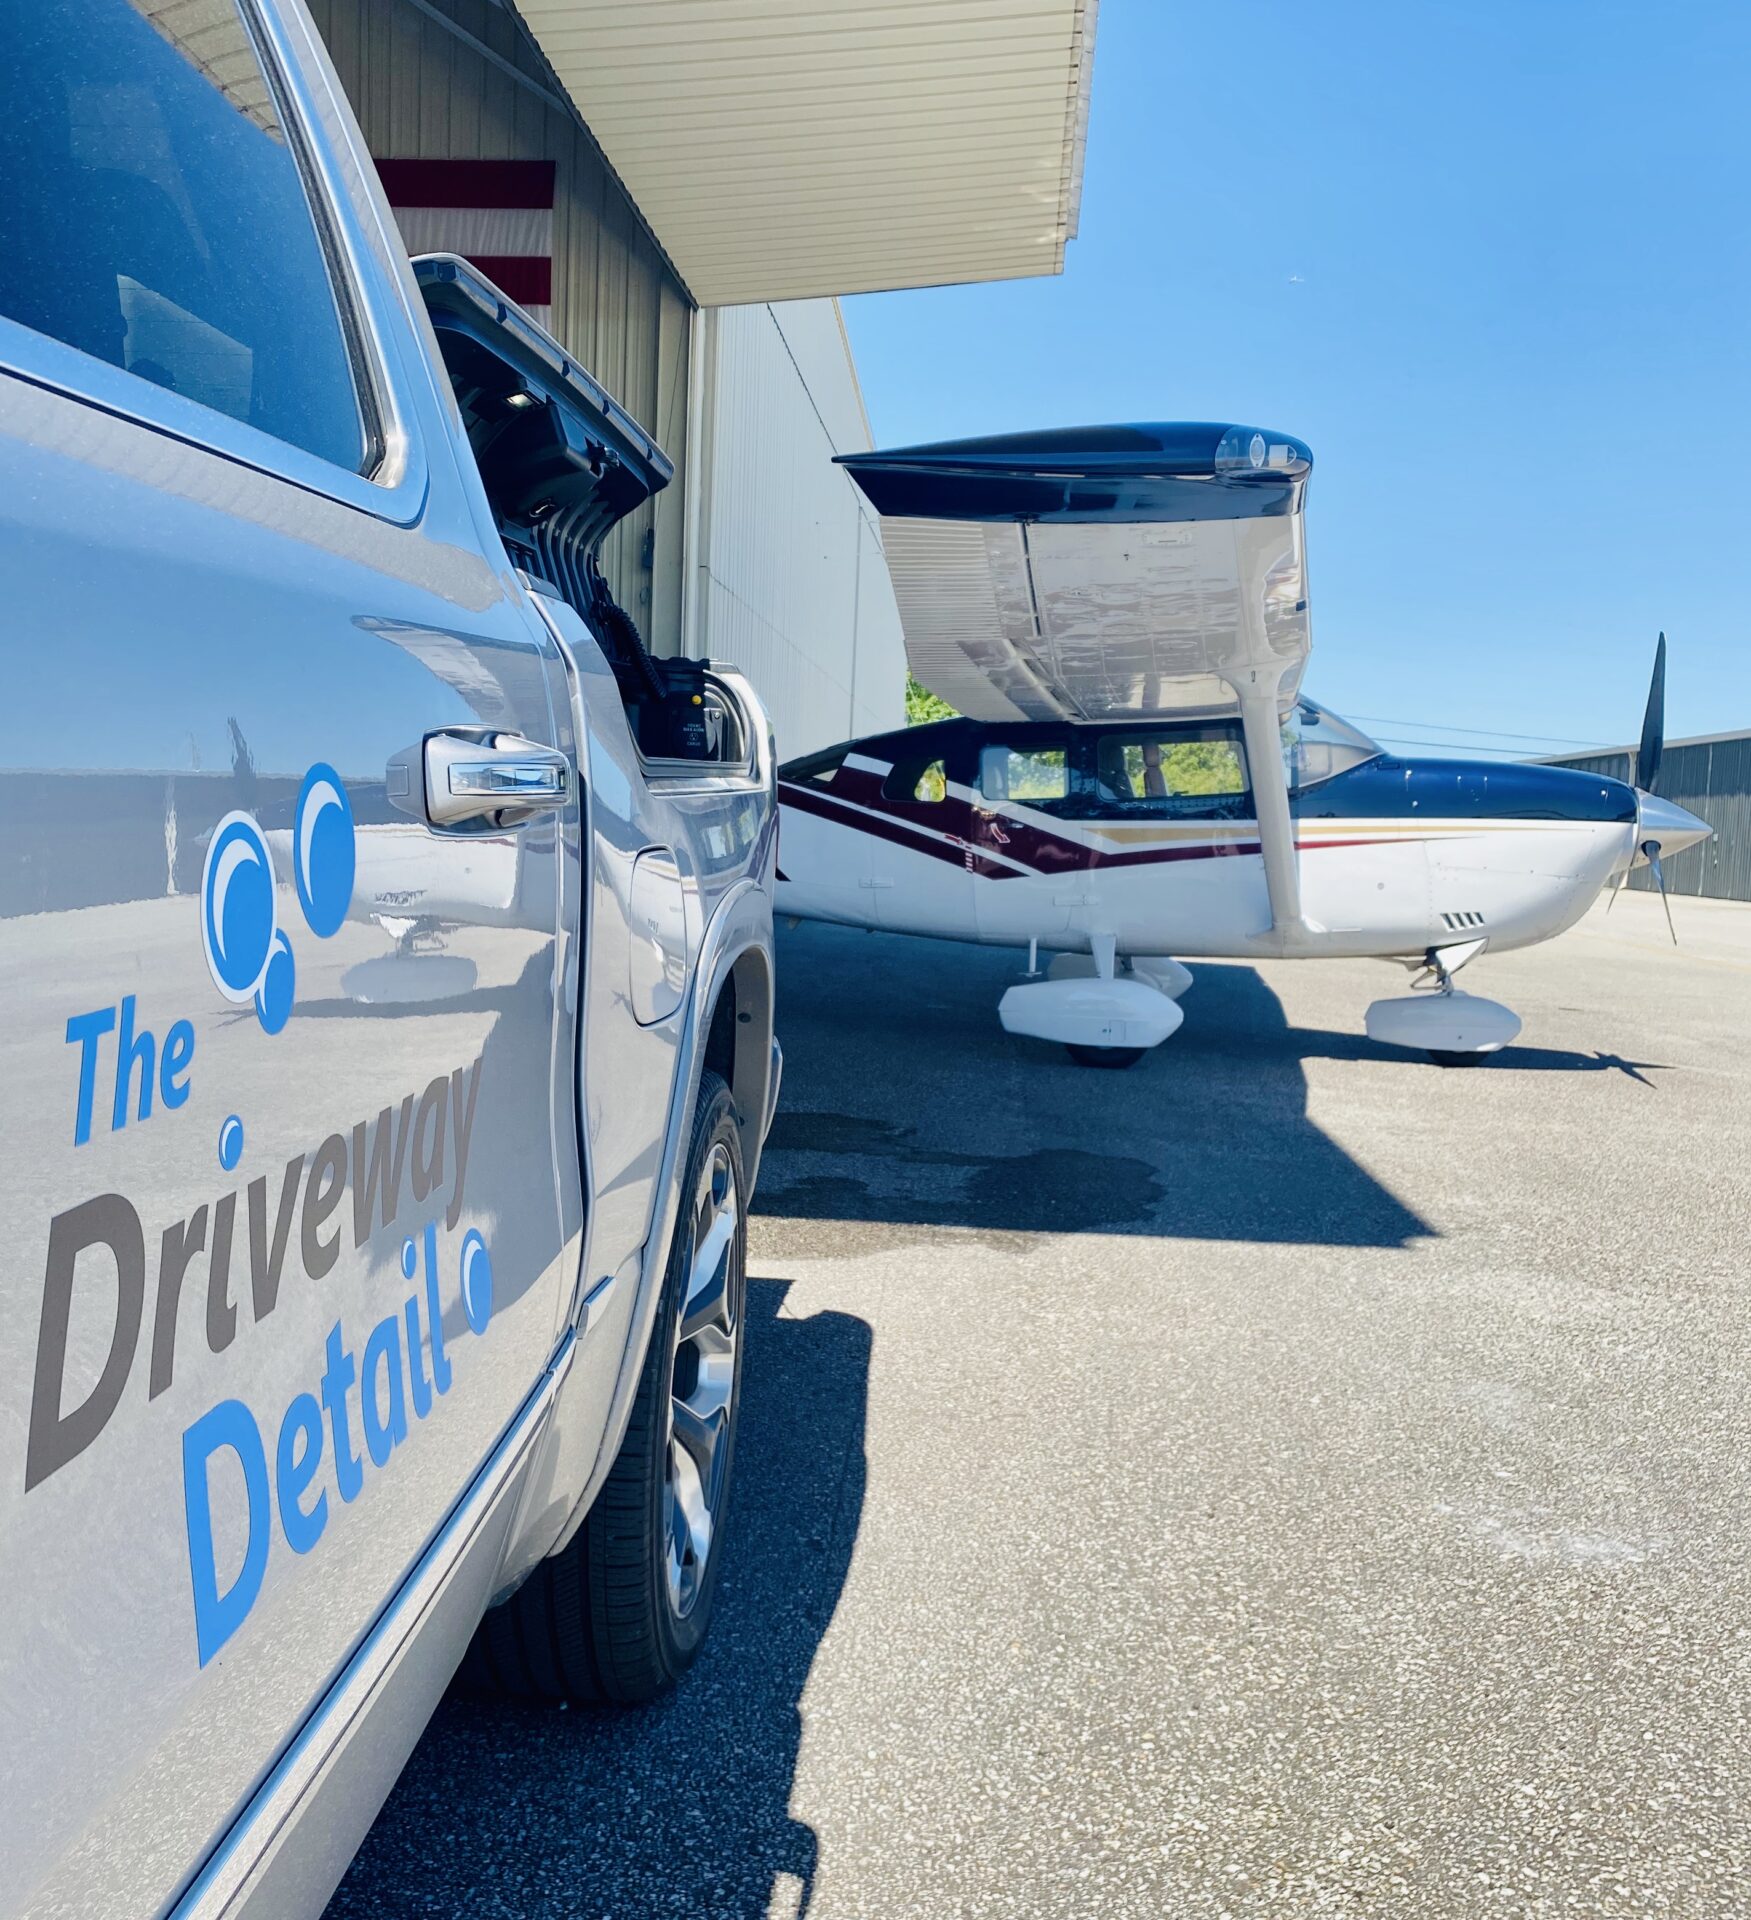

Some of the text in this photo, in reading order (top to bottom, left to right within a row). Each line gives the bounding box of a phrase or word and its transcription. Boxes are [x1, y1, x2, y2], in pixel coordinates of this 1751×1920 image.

[25, 1057, 483, 1494] Driveway
[66, 995, 195, 1146] The
[183, 1221, 452, 1668] Detail
